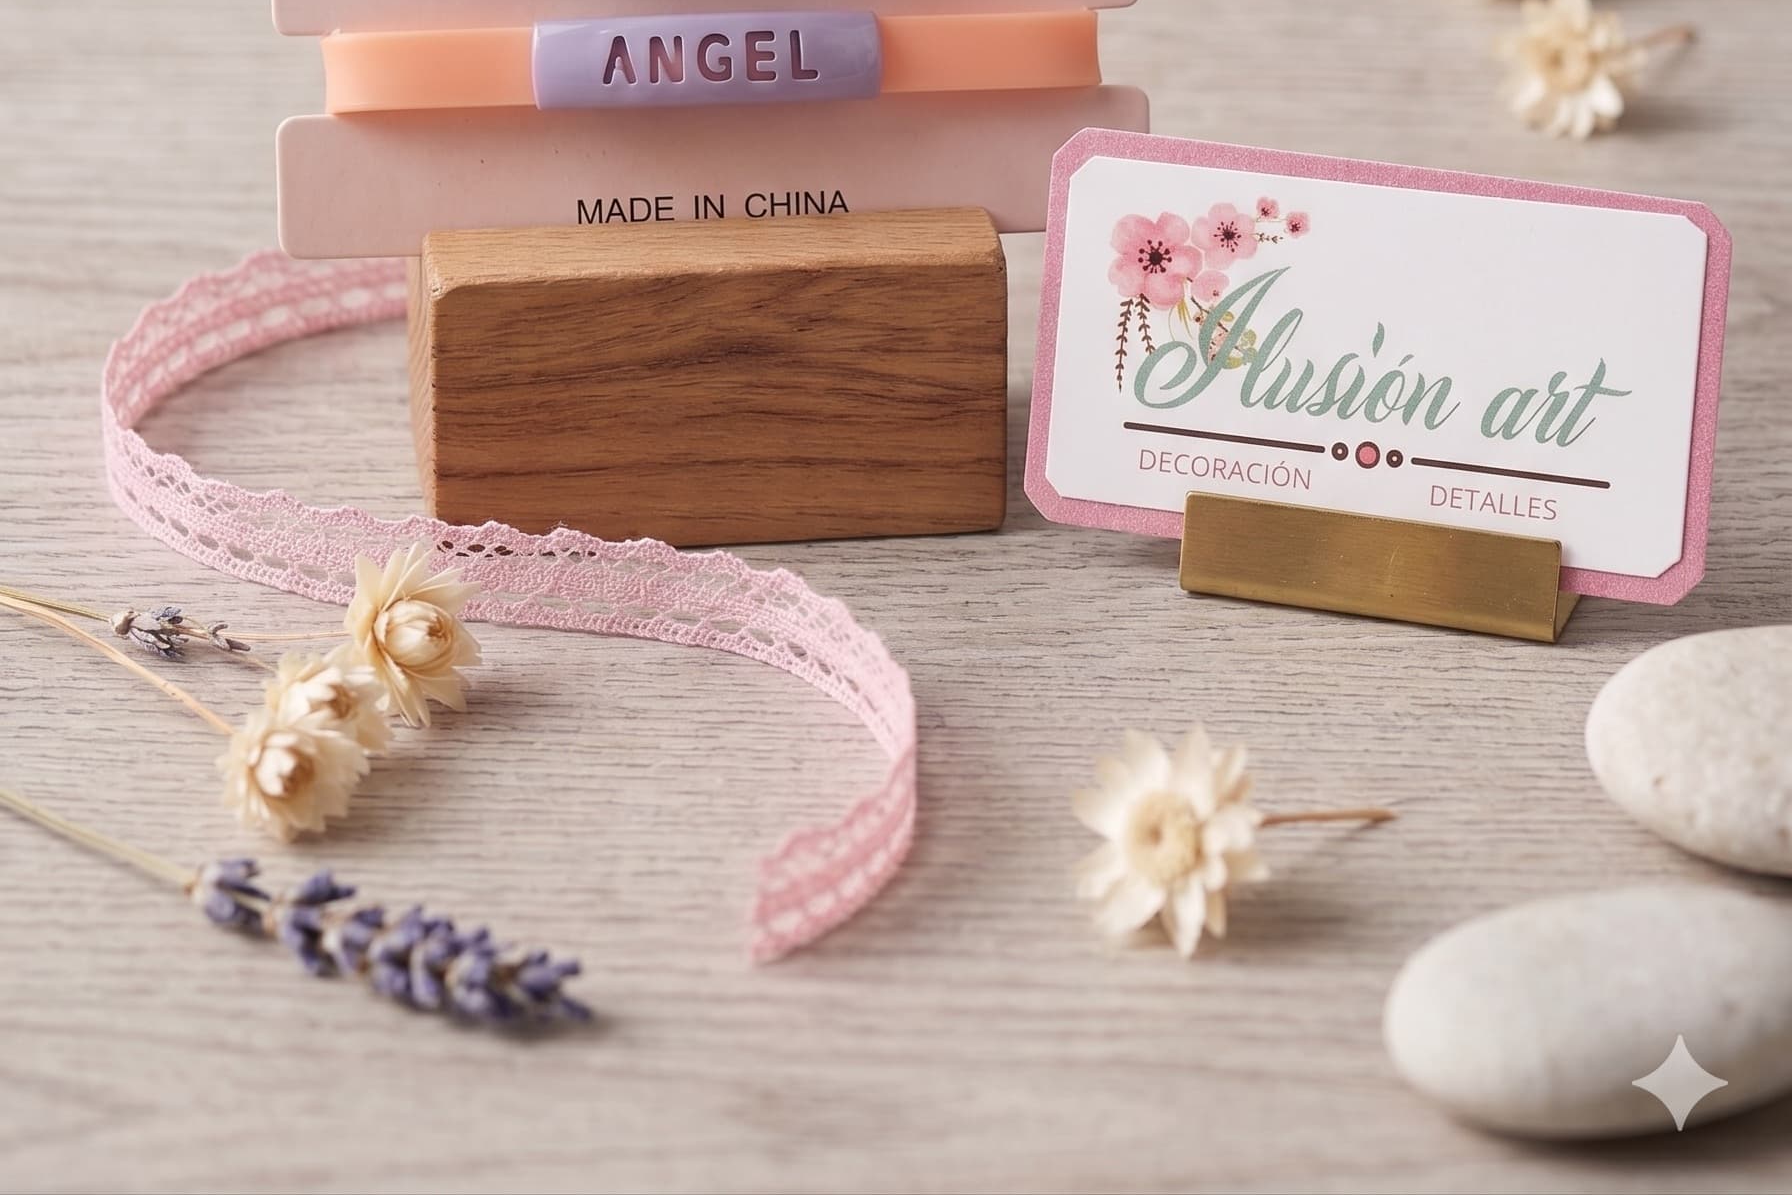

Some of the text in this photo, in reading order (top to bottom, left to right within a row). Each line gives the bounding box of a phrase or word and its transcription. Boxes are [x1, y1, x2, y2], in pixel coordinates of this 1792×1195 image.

[602, 29, 820, 86] ANGEL
[577, 190, 850, 225] MADE IN CHINA
[1133, 266, 1632, 447] Ilusión art
[1138, 448, 1312, 491] DECORACIÓN
[1430, 484, 1558, 521] DETALLES
